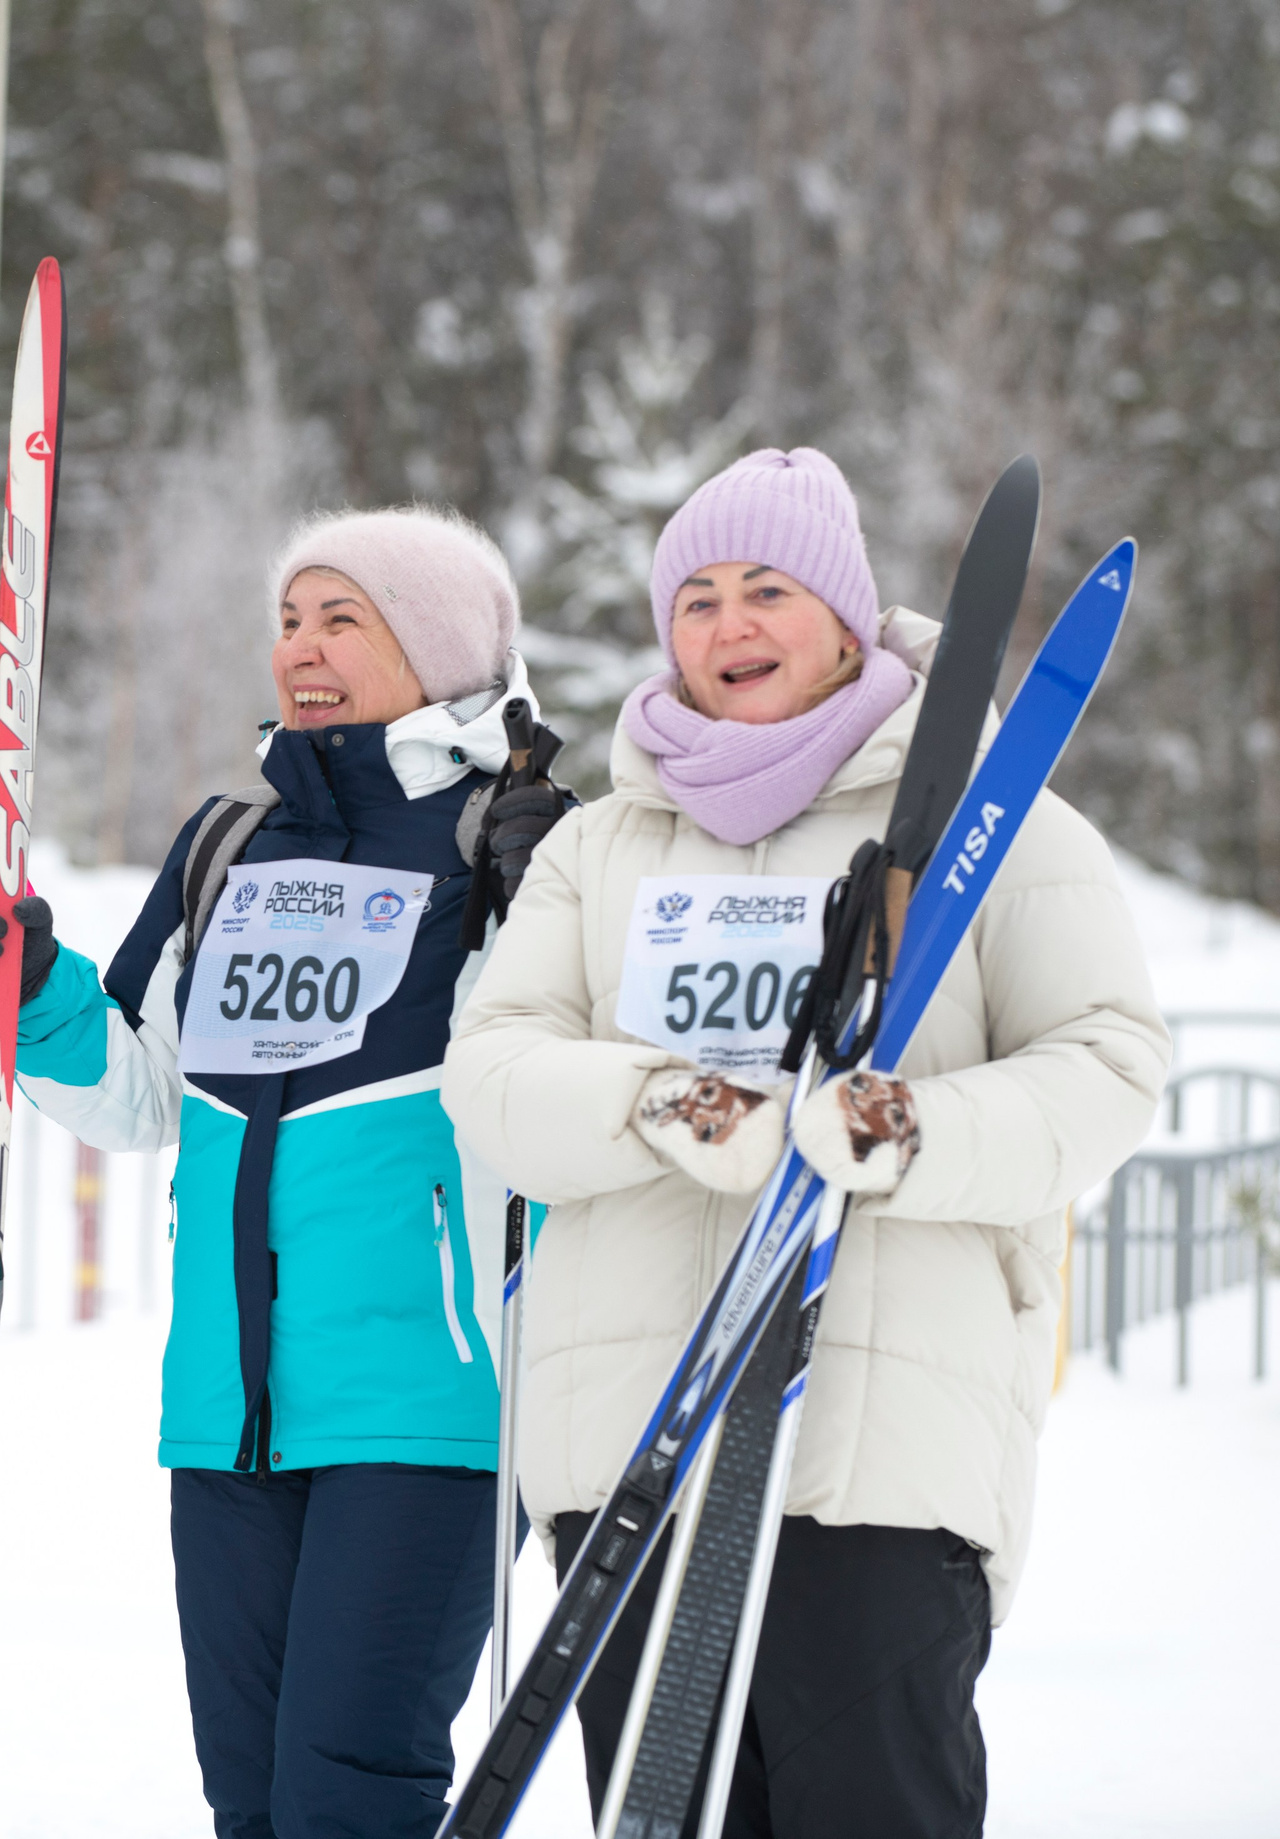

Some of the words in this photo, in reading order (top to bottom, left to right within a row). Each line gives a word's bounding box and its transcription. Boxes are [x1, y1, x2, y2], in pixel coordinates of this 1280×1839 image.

[942, 801, 1006, 895] TISA
[269, 880, 344, 900] ЛЫЖНЯ
[263, 898, 345, 918] РОССИИ
[715, 896, 807, 910] ЛЫЖНЯ
[269, 914, 324, 932] 2025
[707, 911, 806, 924] РОССИИ
[720, 924, 784, 938] 2025
[220, 953, 360, 1023] 5260
[665, 960, 819, 1034] 5206
